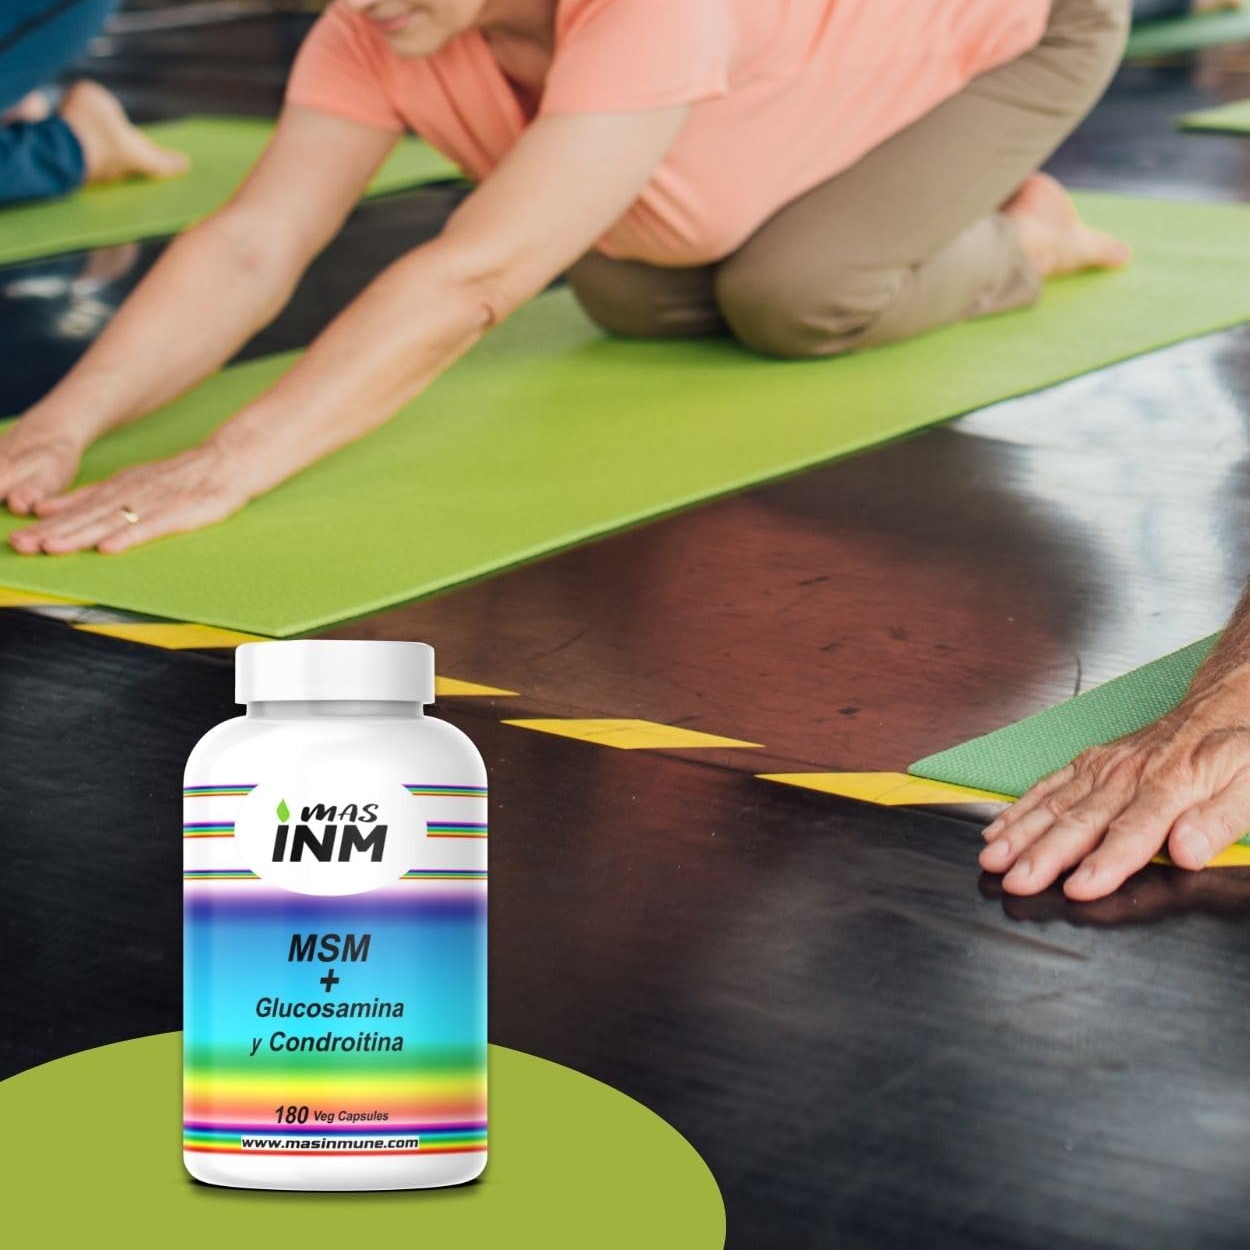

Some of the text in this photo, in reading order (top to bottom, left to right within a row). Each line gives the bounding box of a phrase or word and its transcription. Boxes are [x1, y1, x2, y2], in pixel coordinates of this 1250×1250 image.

[300, 803, 378, 823] MAS
[288, 933, 371, 963] MSM
[256, 997, 404, 1018] Glucosamina
[250, 1031, 404, 1056] y Condroitina
[275, 1105, 389, 1124] 180 Veg Capsules
[242, 1137, 418, 1149] www.masinmune.com
